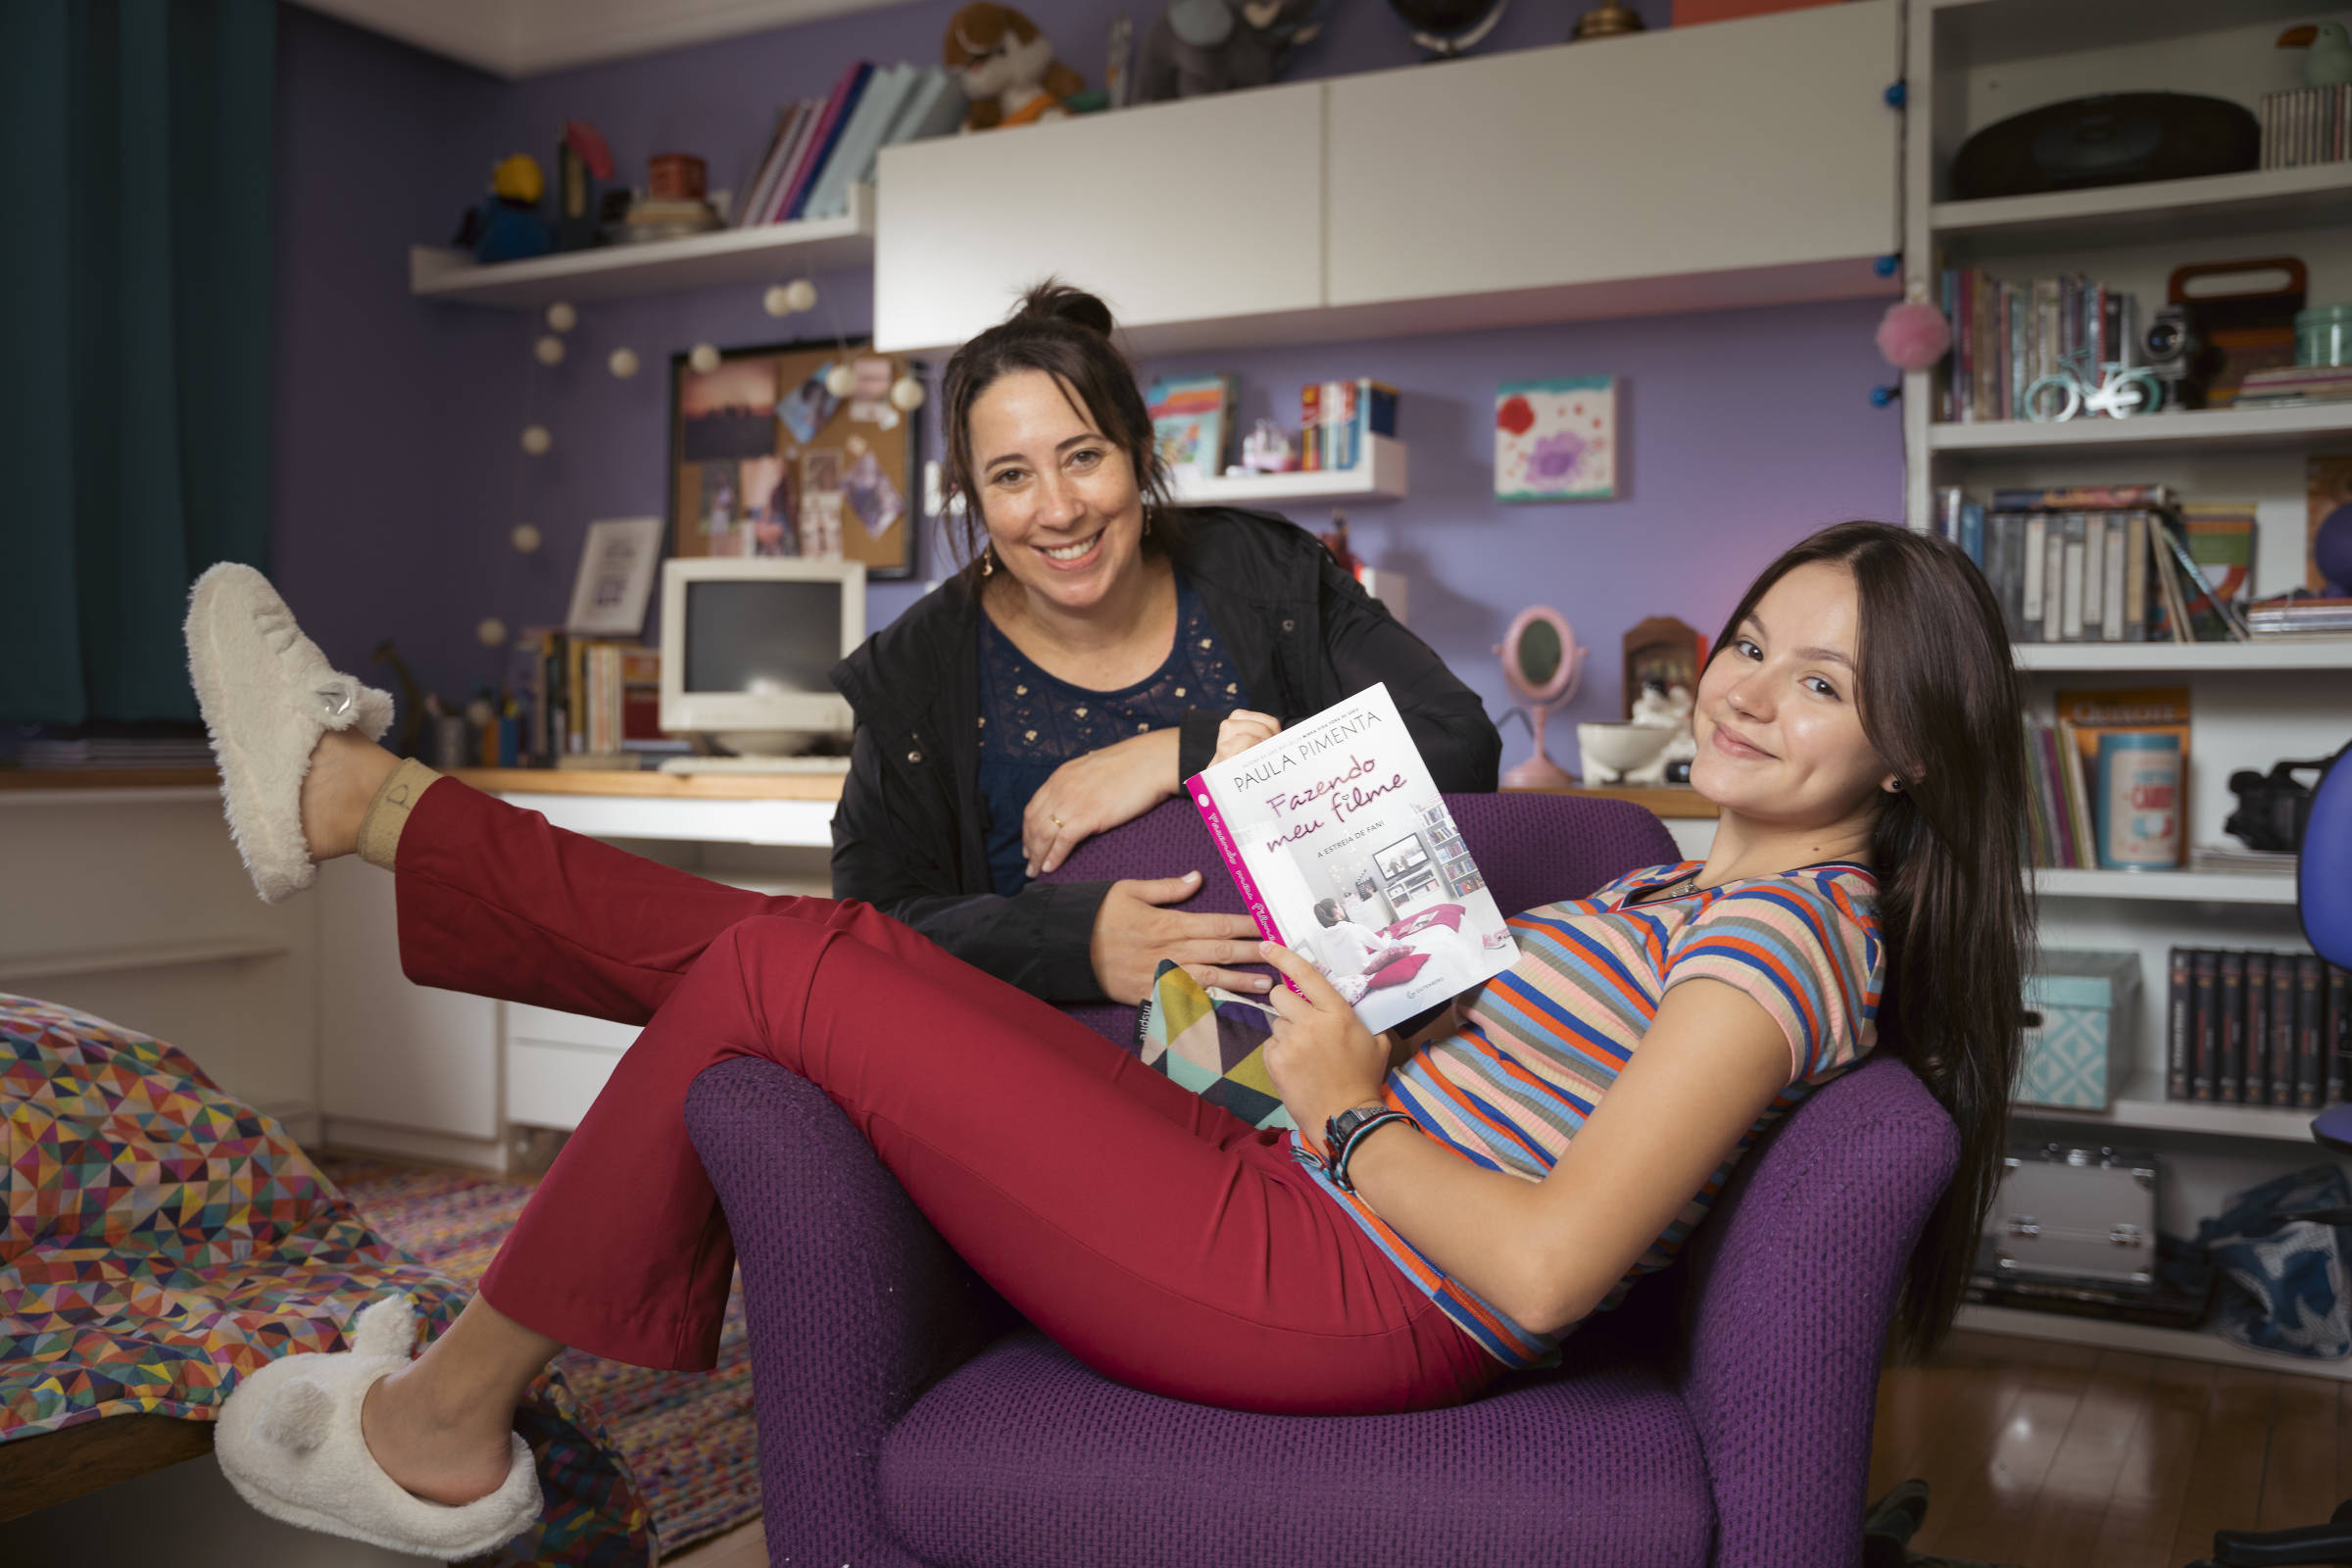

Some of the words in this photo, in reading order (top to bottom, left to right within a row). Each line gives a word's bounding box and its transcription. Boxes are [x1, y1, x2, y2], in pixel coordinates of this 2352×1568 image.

[1234, 755, 1297, 792] PAULA
[1298, 711, 1382, 760] PIMENTA
[1265, 755, 1375, 817] Fazendo
[1266, 820, 1325, 853] meu
[1331, 774, 1407, 822] filme
[1324, 836, 1353, 855] ESTREIA
[1354, 830, 1366, 839] DE
